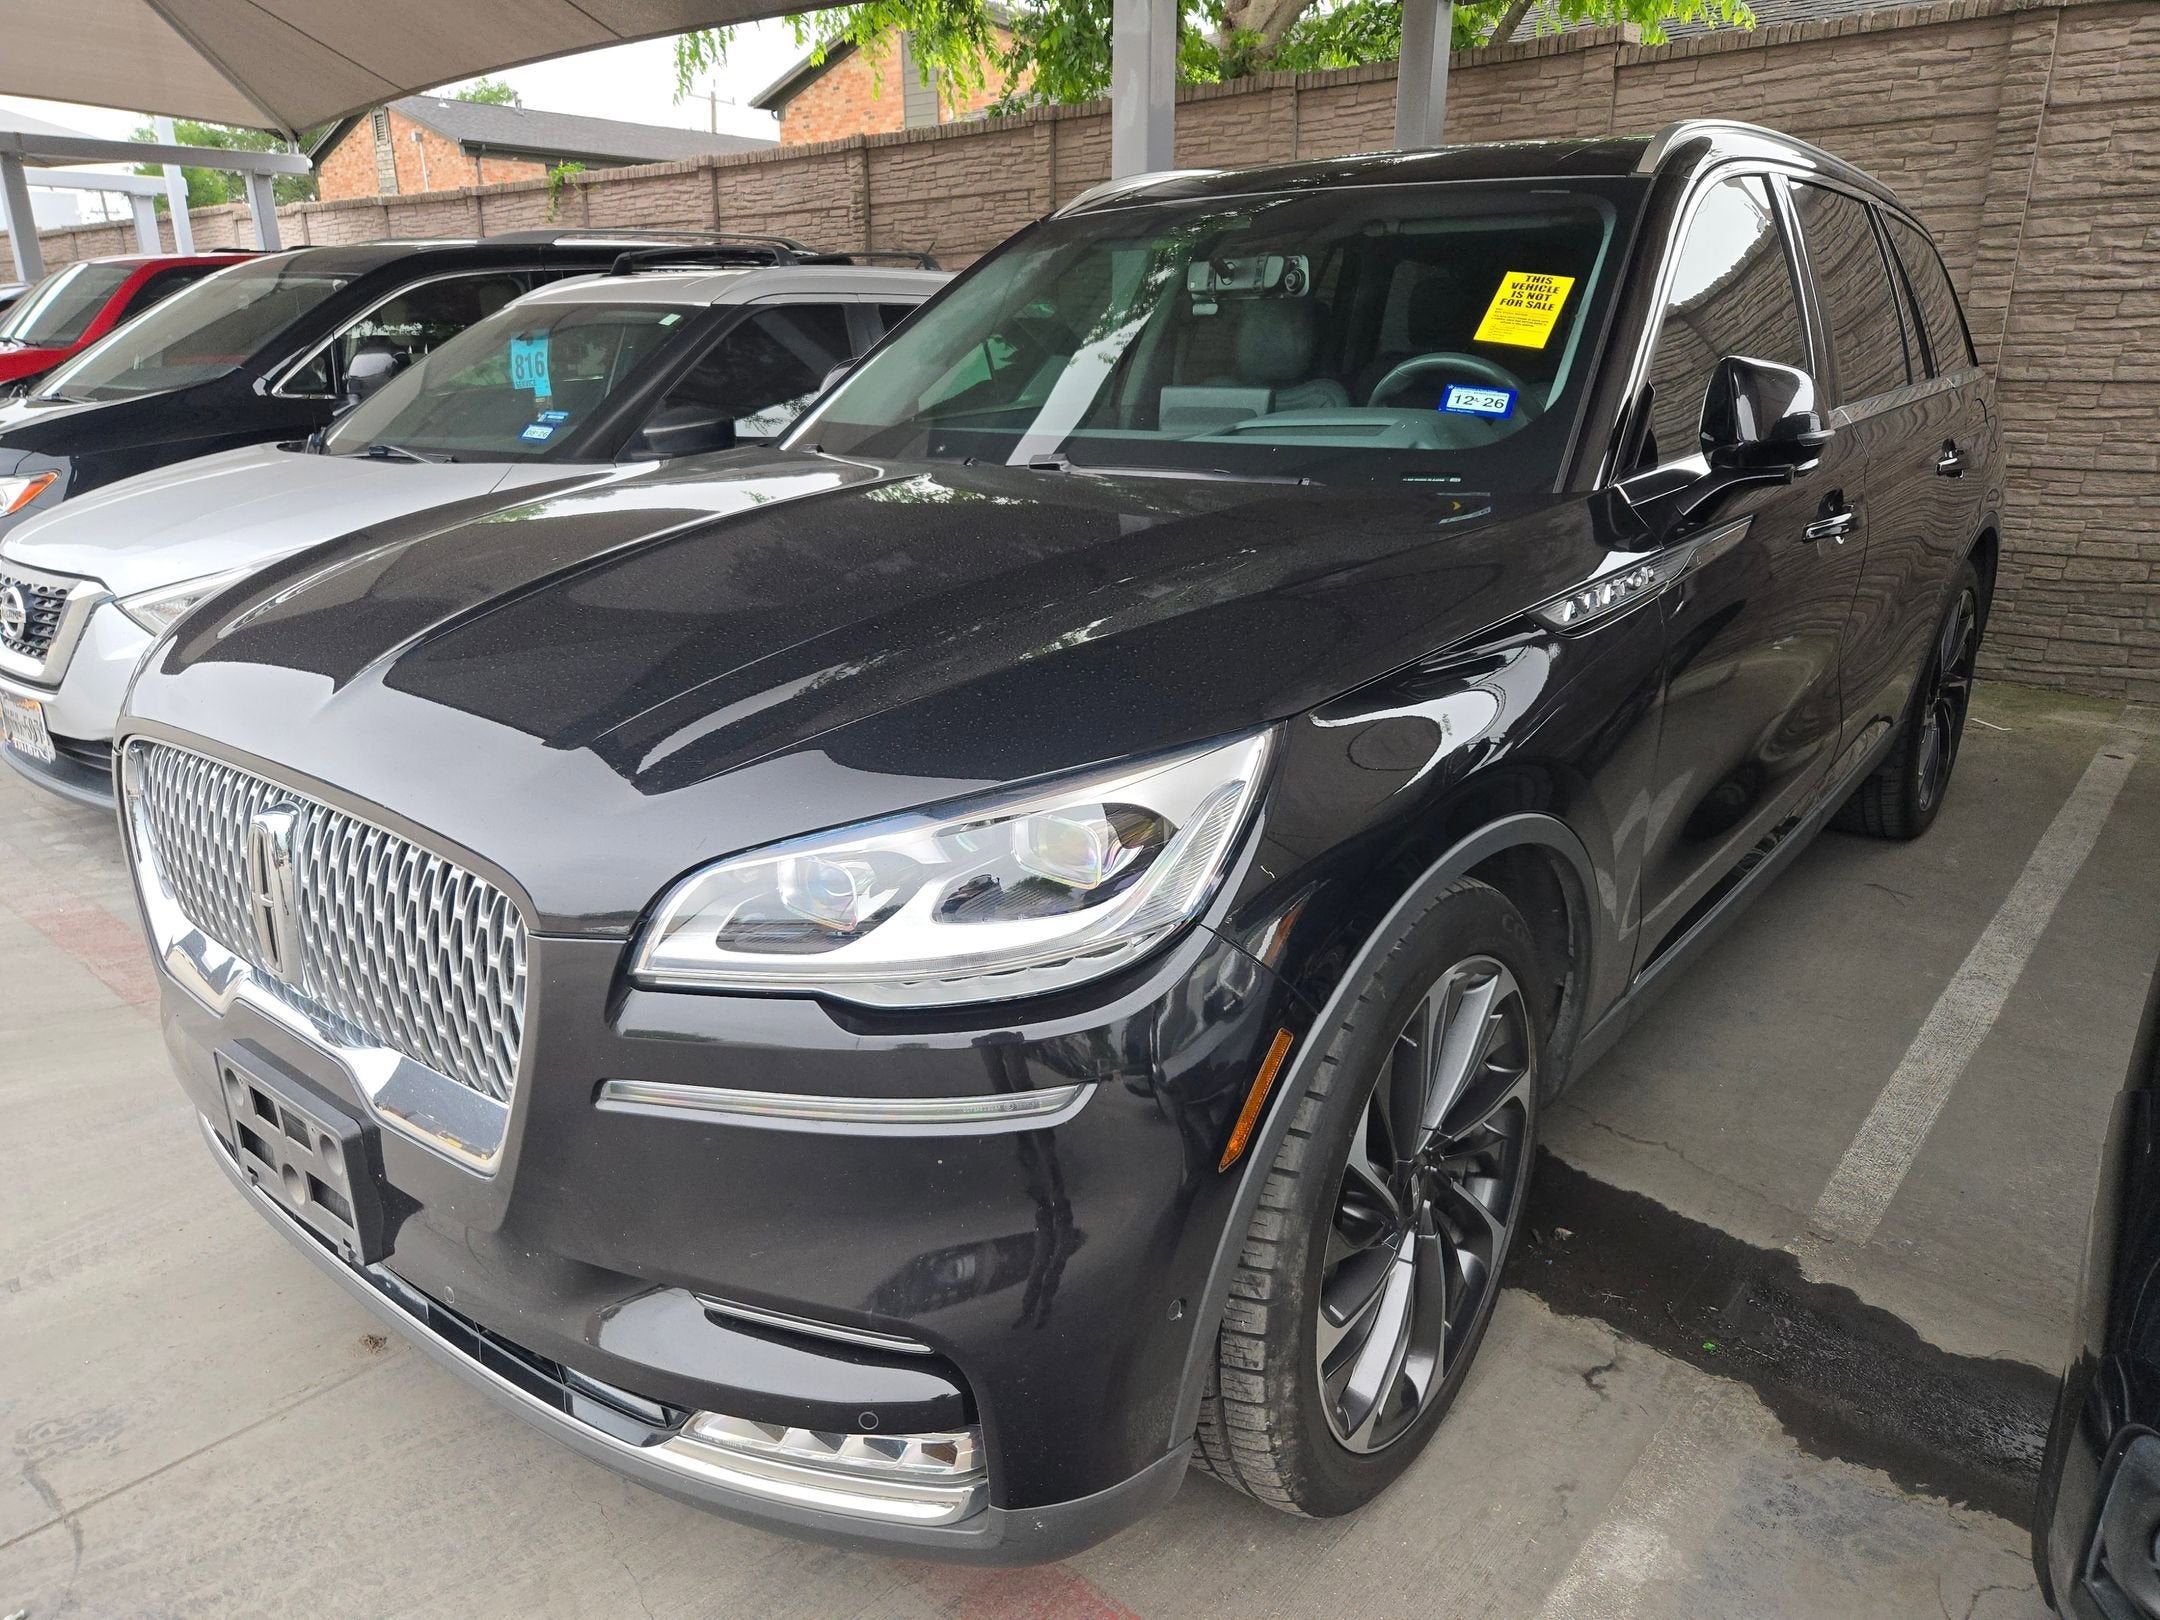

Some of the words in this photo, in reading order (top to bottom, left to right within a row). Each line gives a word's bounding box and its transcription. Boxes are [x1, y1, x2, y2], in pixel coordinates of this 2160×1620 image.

[1525, 275, 1553, 285] THIS
[1511, 282, 1561, 295] VEHICLE
[1511, 291, 1524, 299] IS
[1526, 292, 1552, 302] NOT
[1499, 298, 1524, 307] FOR
[1525, 301, 1556, 312] SALE
[515, 351, 545, 380] 816
[1454, 394, 1475, 406] 12
[1482, 397, 1506, 409] 26
[1562, 565, 1654, 622] AVIATOR
